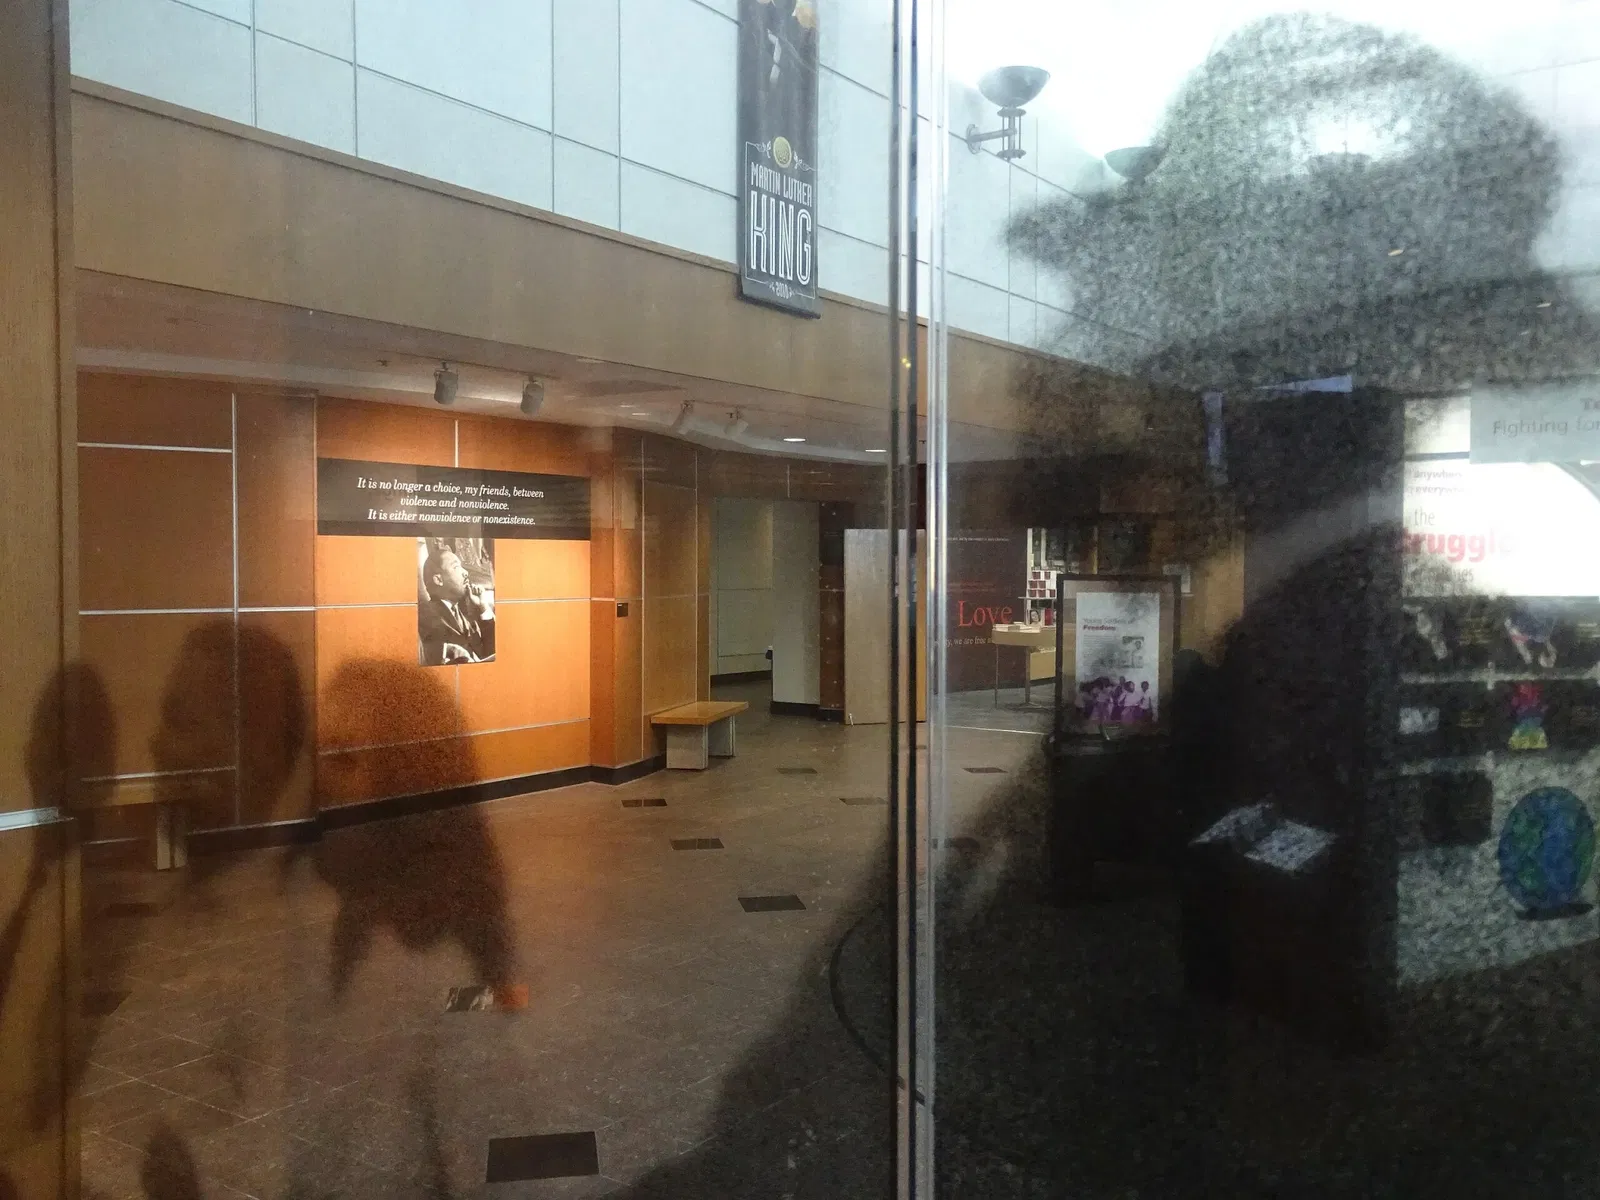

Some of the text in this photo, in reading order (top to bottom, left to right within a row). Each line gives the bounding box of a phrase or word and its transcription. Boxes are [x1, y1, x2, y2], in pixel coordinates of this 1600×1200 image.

[751, 161, 812, 208] MARTIN LUTHER
[751, 189, 811, 286] KING
[1493, 418, 1569, 437] Fighting
[357, 477, 545, 498] It is no longer a choice, my friends, between
[400, 495, 510, 510] violence and nonviolence.
[367, 508, 536, 525] It is either nonviolence or nonexistence.
[1414, 507, 1436, 526] the
[958, 600, 1013, 628] Love
[963, 637, 975, 646] are
